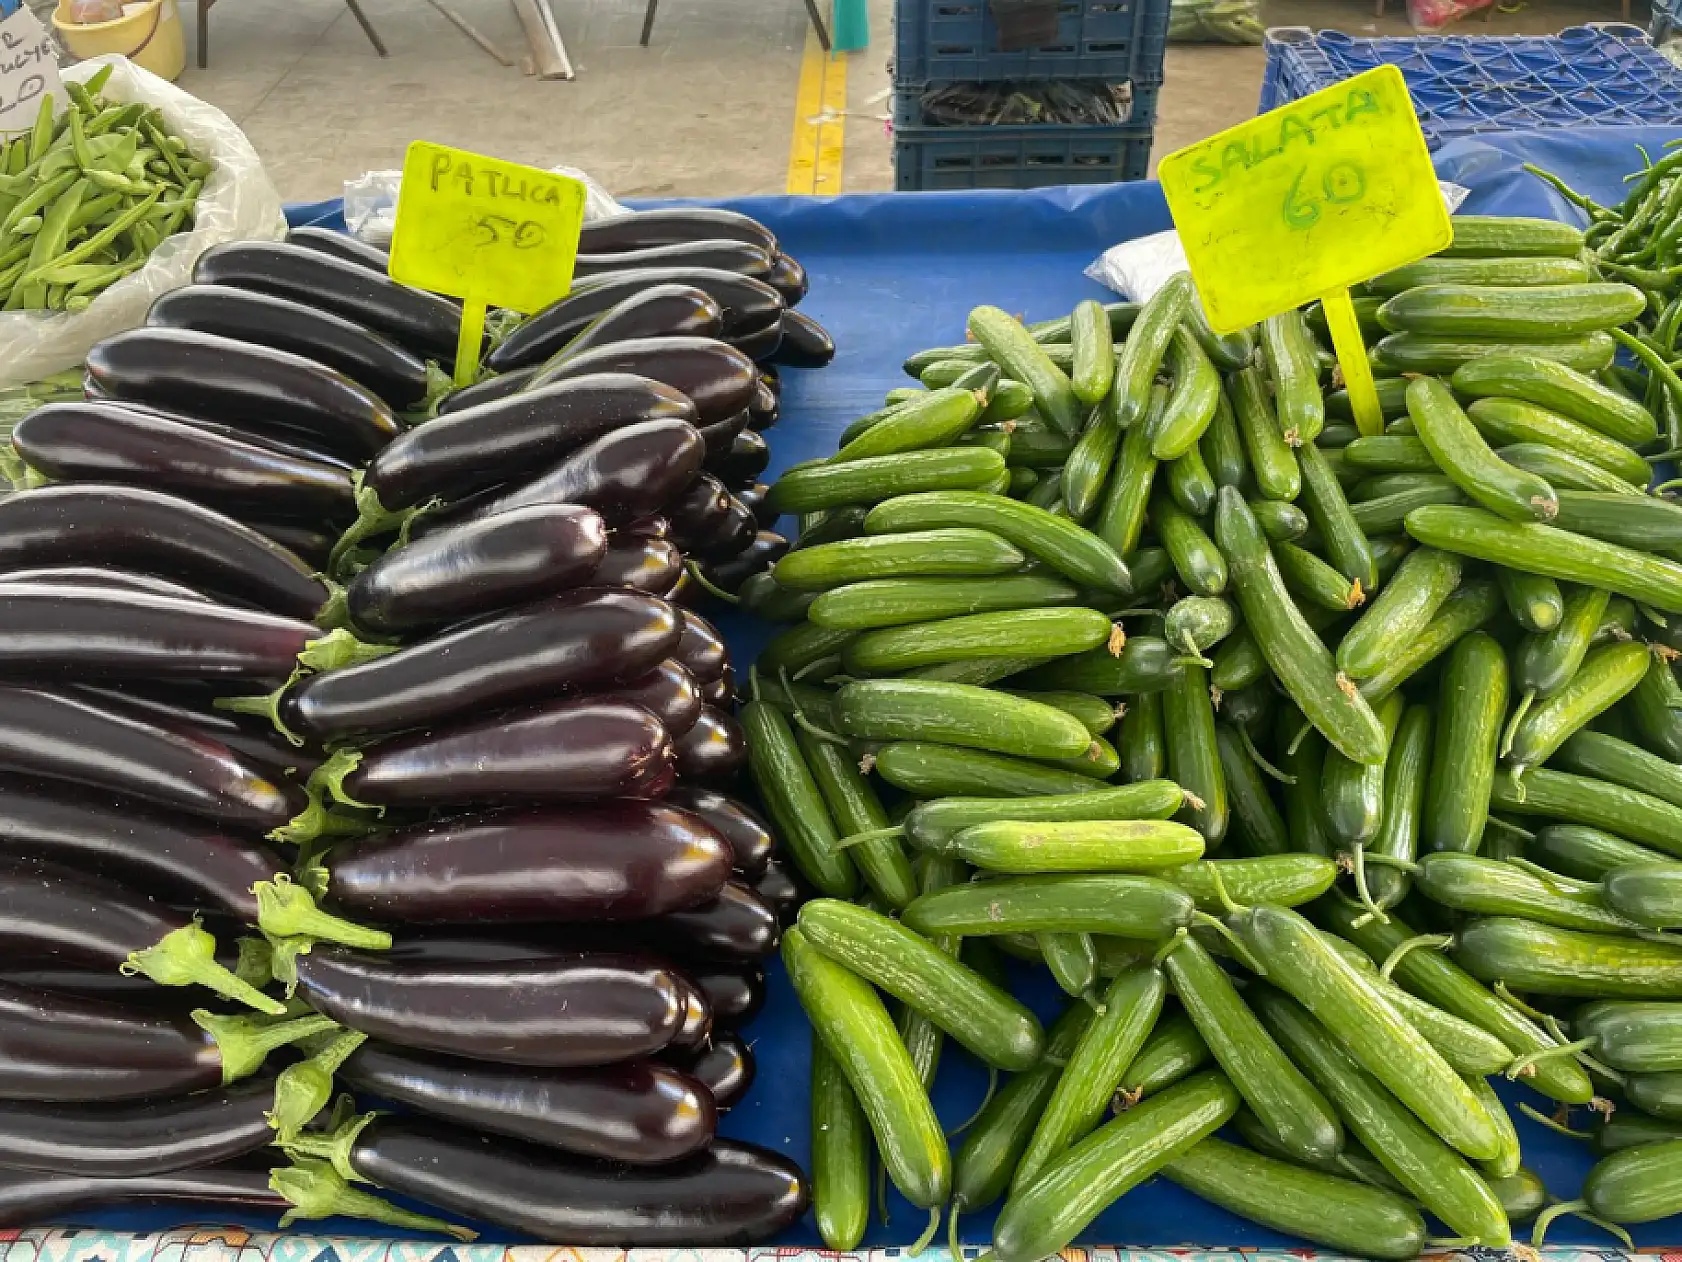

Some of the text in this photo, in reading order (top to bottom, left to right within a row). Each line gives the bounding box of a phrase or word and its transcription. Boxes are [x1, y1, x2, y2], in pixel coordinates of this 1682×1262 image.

[1189, 86, 1380, 194] SALATA
[1283, 161, 1366, 230] 60
[474, 214, 548, 250] 50
